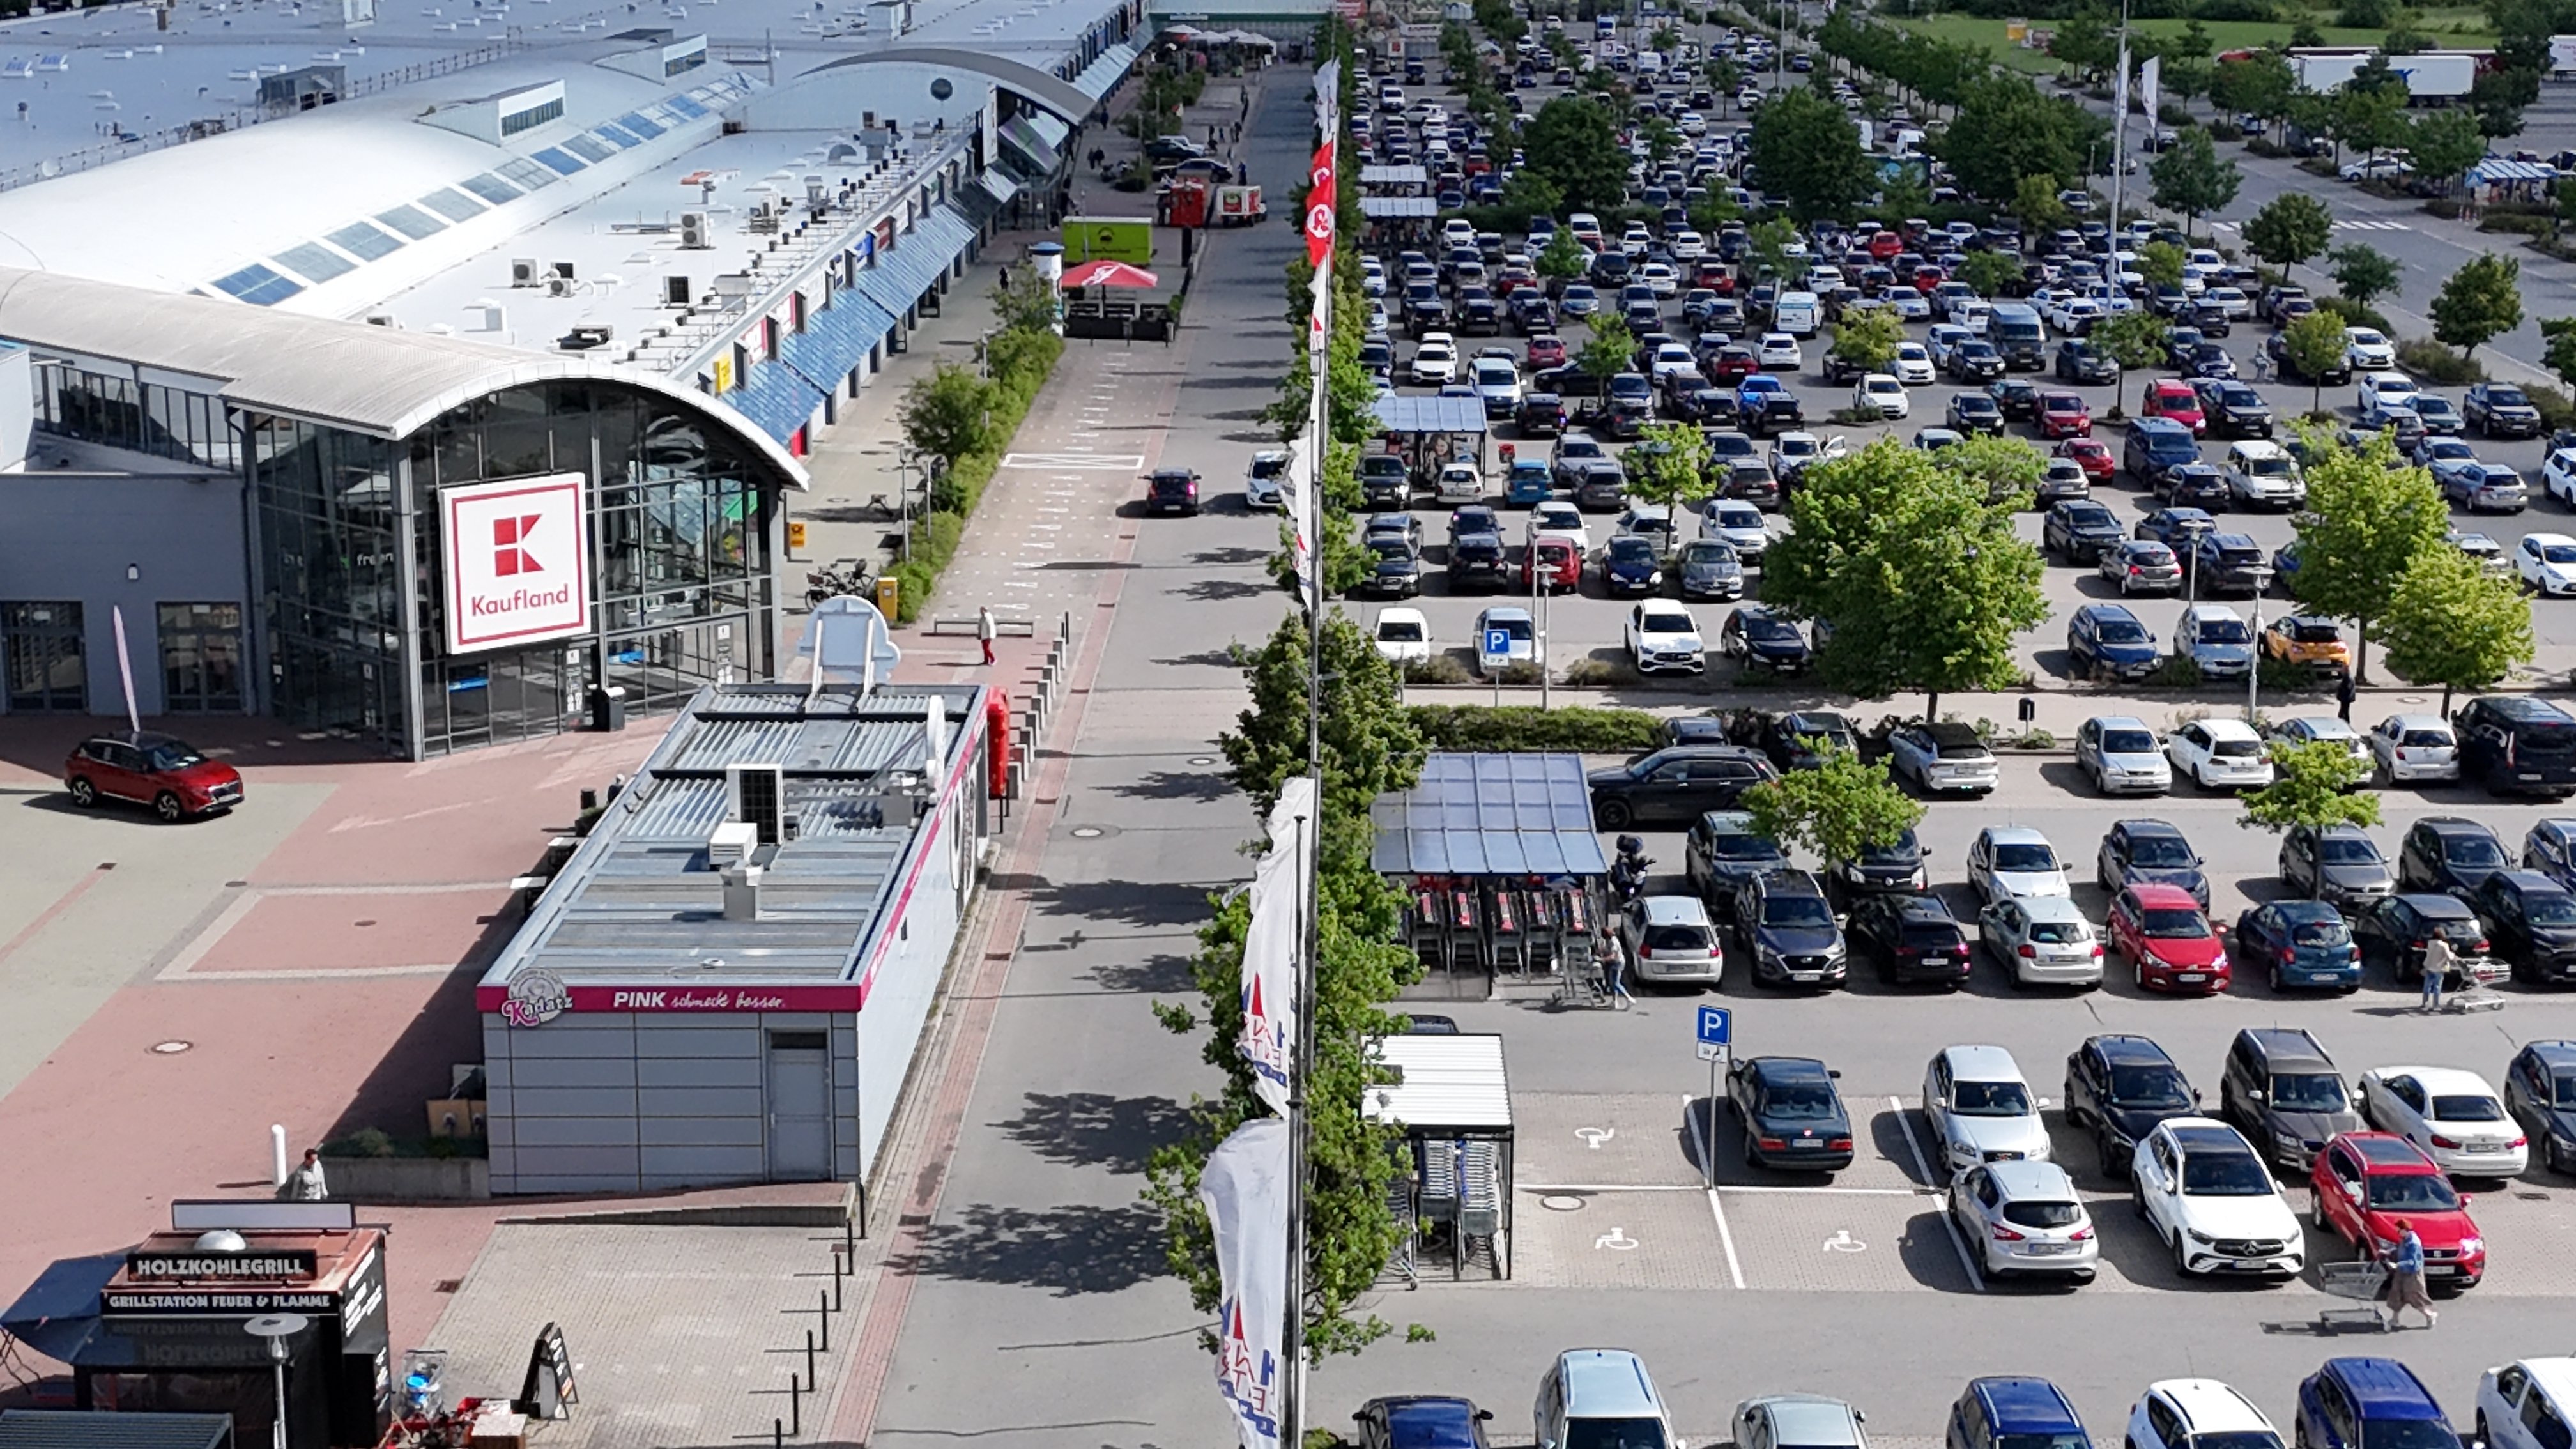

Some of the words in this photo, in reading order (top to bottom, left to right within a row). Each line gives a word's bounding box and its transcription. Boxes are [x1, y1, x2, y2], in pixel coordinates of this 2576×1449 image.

[471, 583, 569, 618] Kaufland
[1490, 632, 1505, 650] P
[613, 991, 667, 1008] PINK
[670, 991, 730, 1008] schmeckt
[1704, 1011, 1722, 1037] P
[137, 1259, 305, 1275] HOLZKOHLEGRILL
[109, 1295, 208, 1308] GRILLSTATION
[211, 1296, 253, 1308] FEUER
[256, 1296, 268, 1308] &
[272, 1295, 330, 1308] FLAMME
